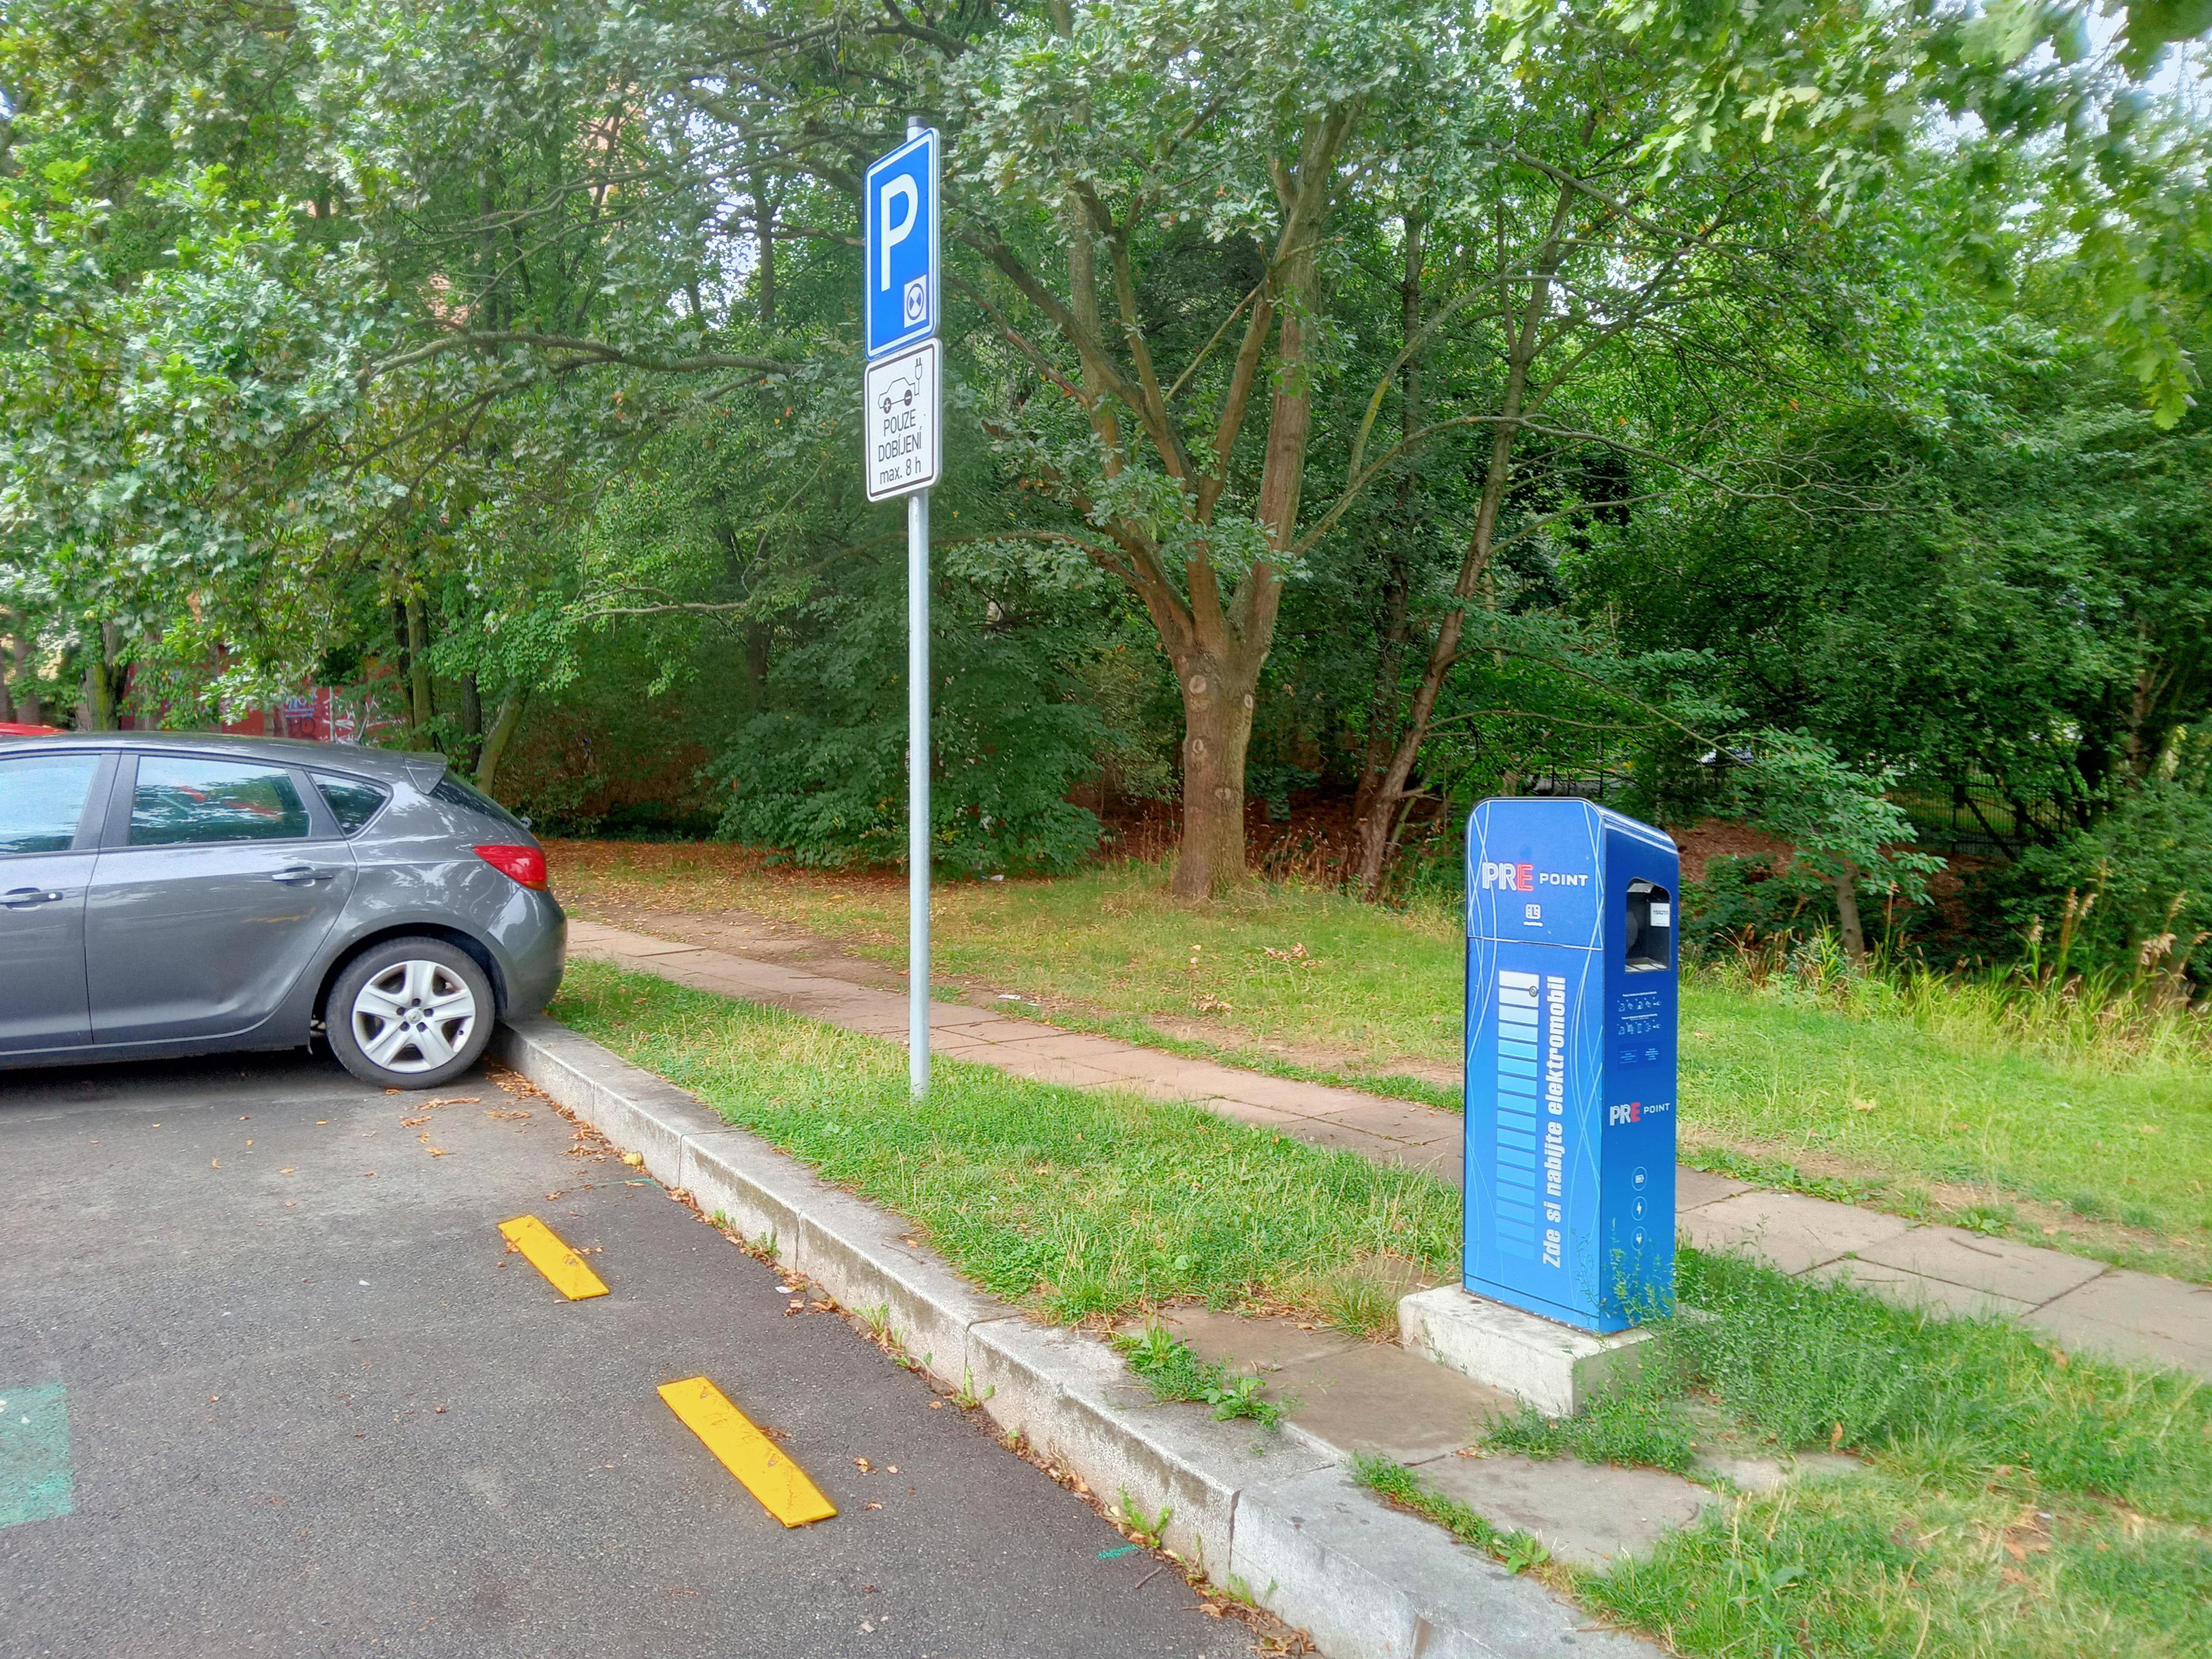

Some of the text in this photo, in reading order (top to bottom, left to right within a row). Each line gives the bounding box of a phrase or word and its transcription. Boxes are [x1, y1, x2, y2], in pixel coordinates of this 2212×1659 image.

[880, 173, 918, 292] P
[884, 409, 916, 436] POUZE
[878, 426, 922, 462] DOBÍJENÍ
[880, 456, 921, 484] max. 8 h
[1481, 861, 1589, 891] PRE POINT
[1542, 975, 1566, 1269] Zde si nabijte elektromobil
[1609, 1102, 1670, 1126] PRE POINT
